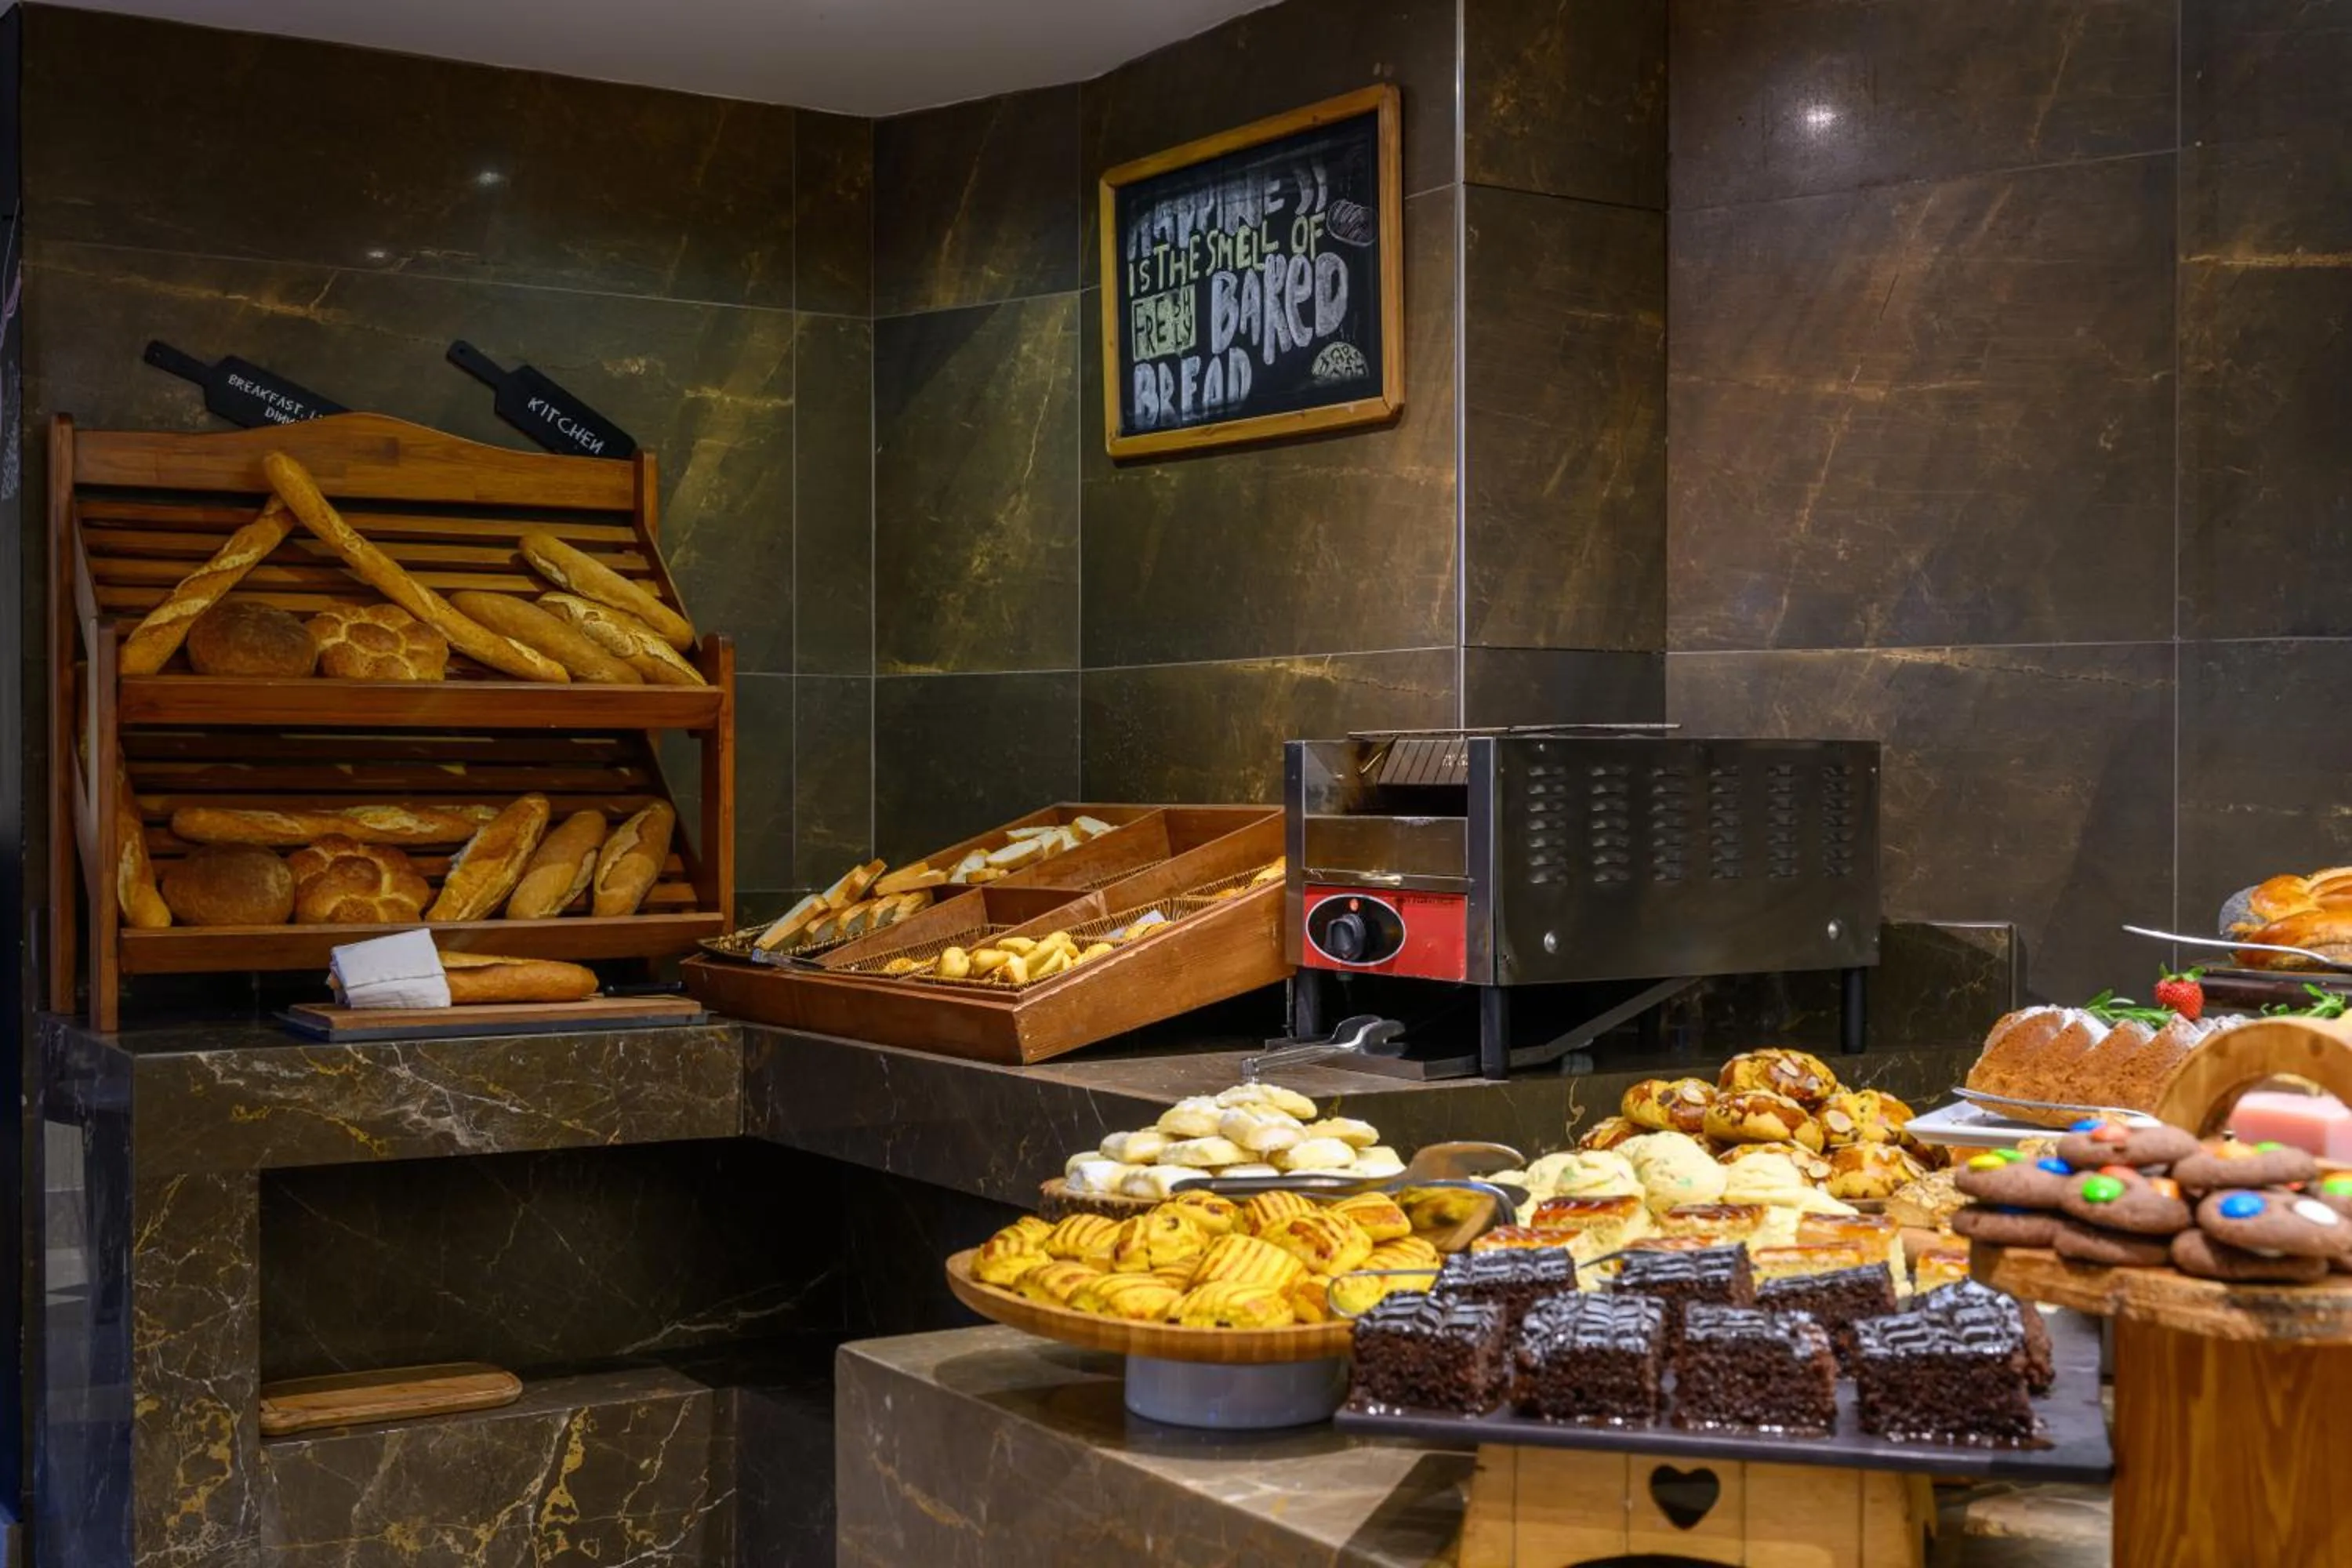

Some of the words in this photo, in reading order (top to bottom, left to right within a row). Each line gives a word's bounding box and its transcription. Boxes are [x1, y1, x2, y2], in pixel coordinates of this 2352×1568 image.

[1128, 258, 1150, 296] IS
[1153, 234, 1200, 290] THE
[1206, 220, 1279, 277] SMELL
[1290, 212, 1327, 260] OF
[528, 397, 604, 454] KITCHEN
[1133, 347, 1253, 429] BREAD
